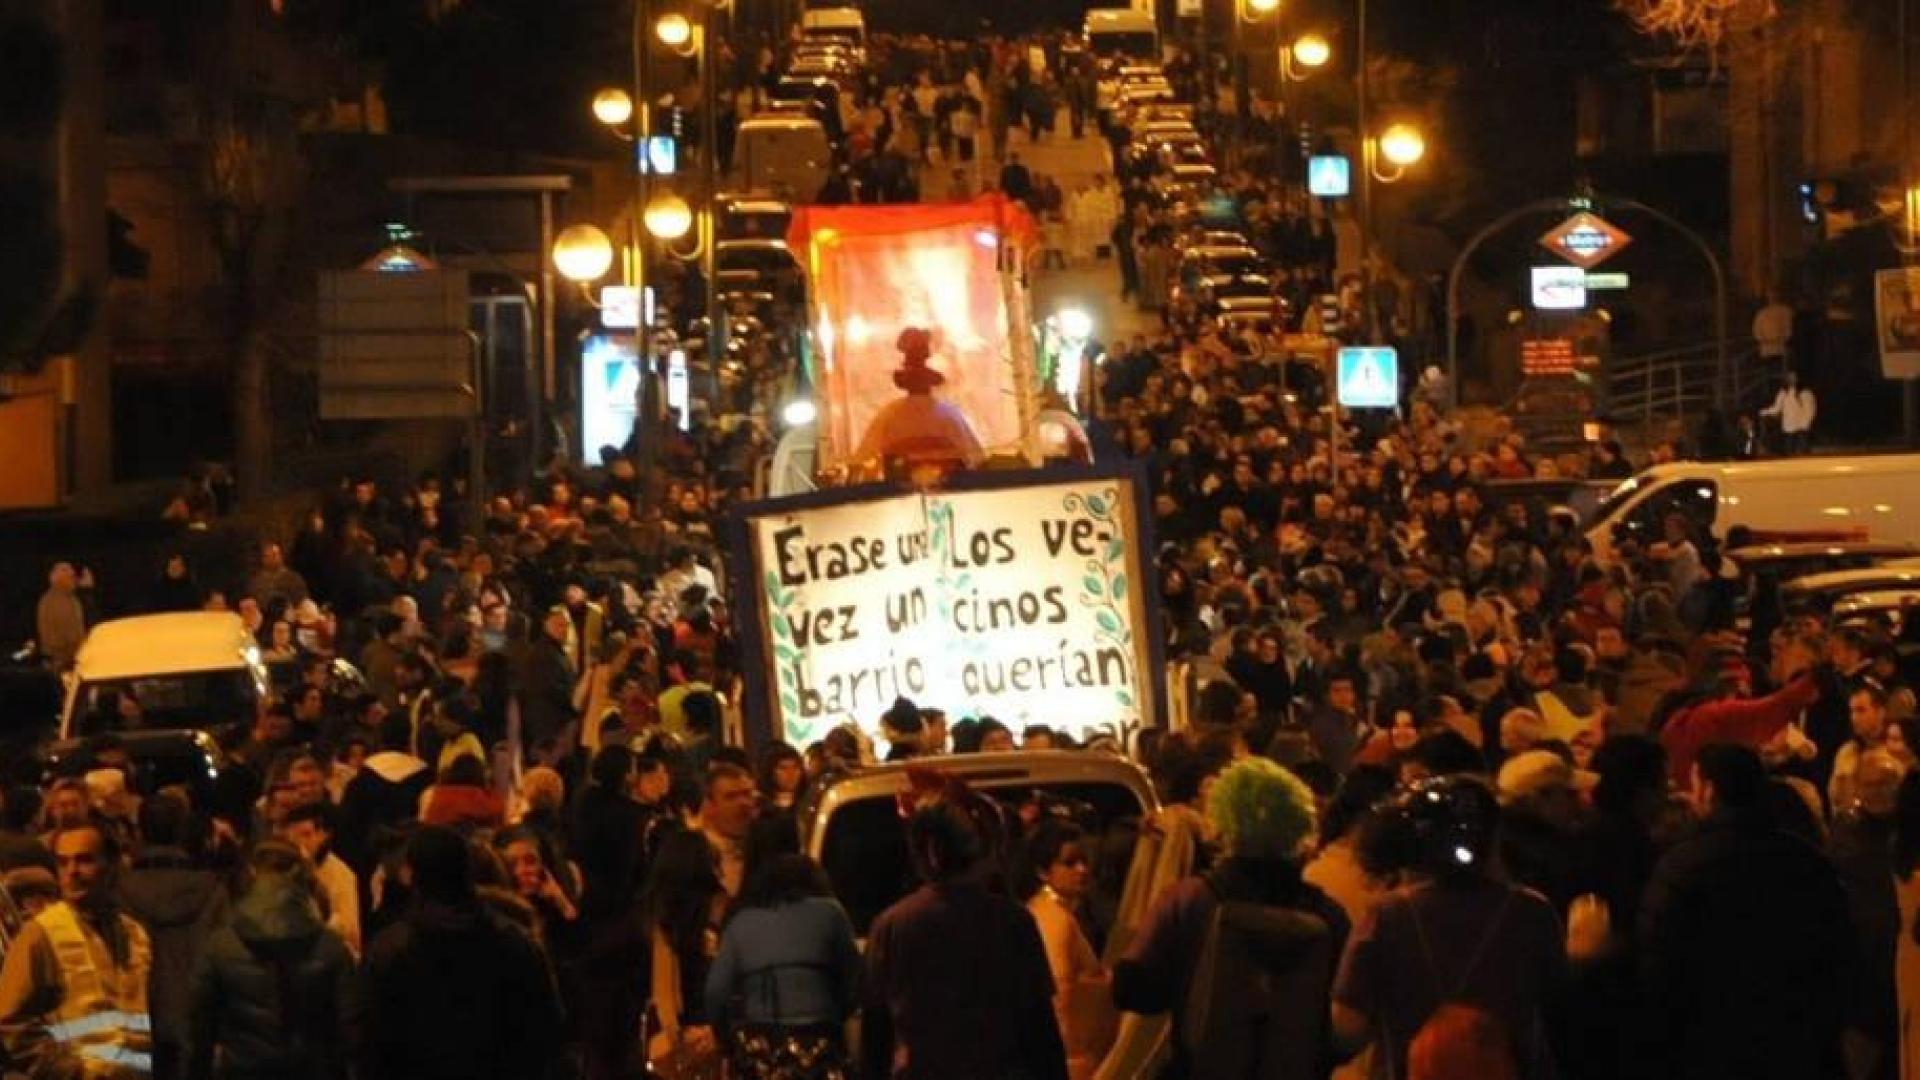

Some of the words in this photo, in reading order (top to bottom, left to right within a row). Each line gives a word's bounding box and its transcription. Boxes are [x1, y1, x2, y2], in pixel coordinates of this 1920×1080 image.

[773, 516, 888, 586] Érase
[950, 507, 1015, 567] Los
[1042, 519, 1110, 558] ve-
[788, 605, 859, 648] vez
[887, 587, 926, 633] un
[953, 586, 1067, 633] cinos
[793, 649, 925, 718] barrio
